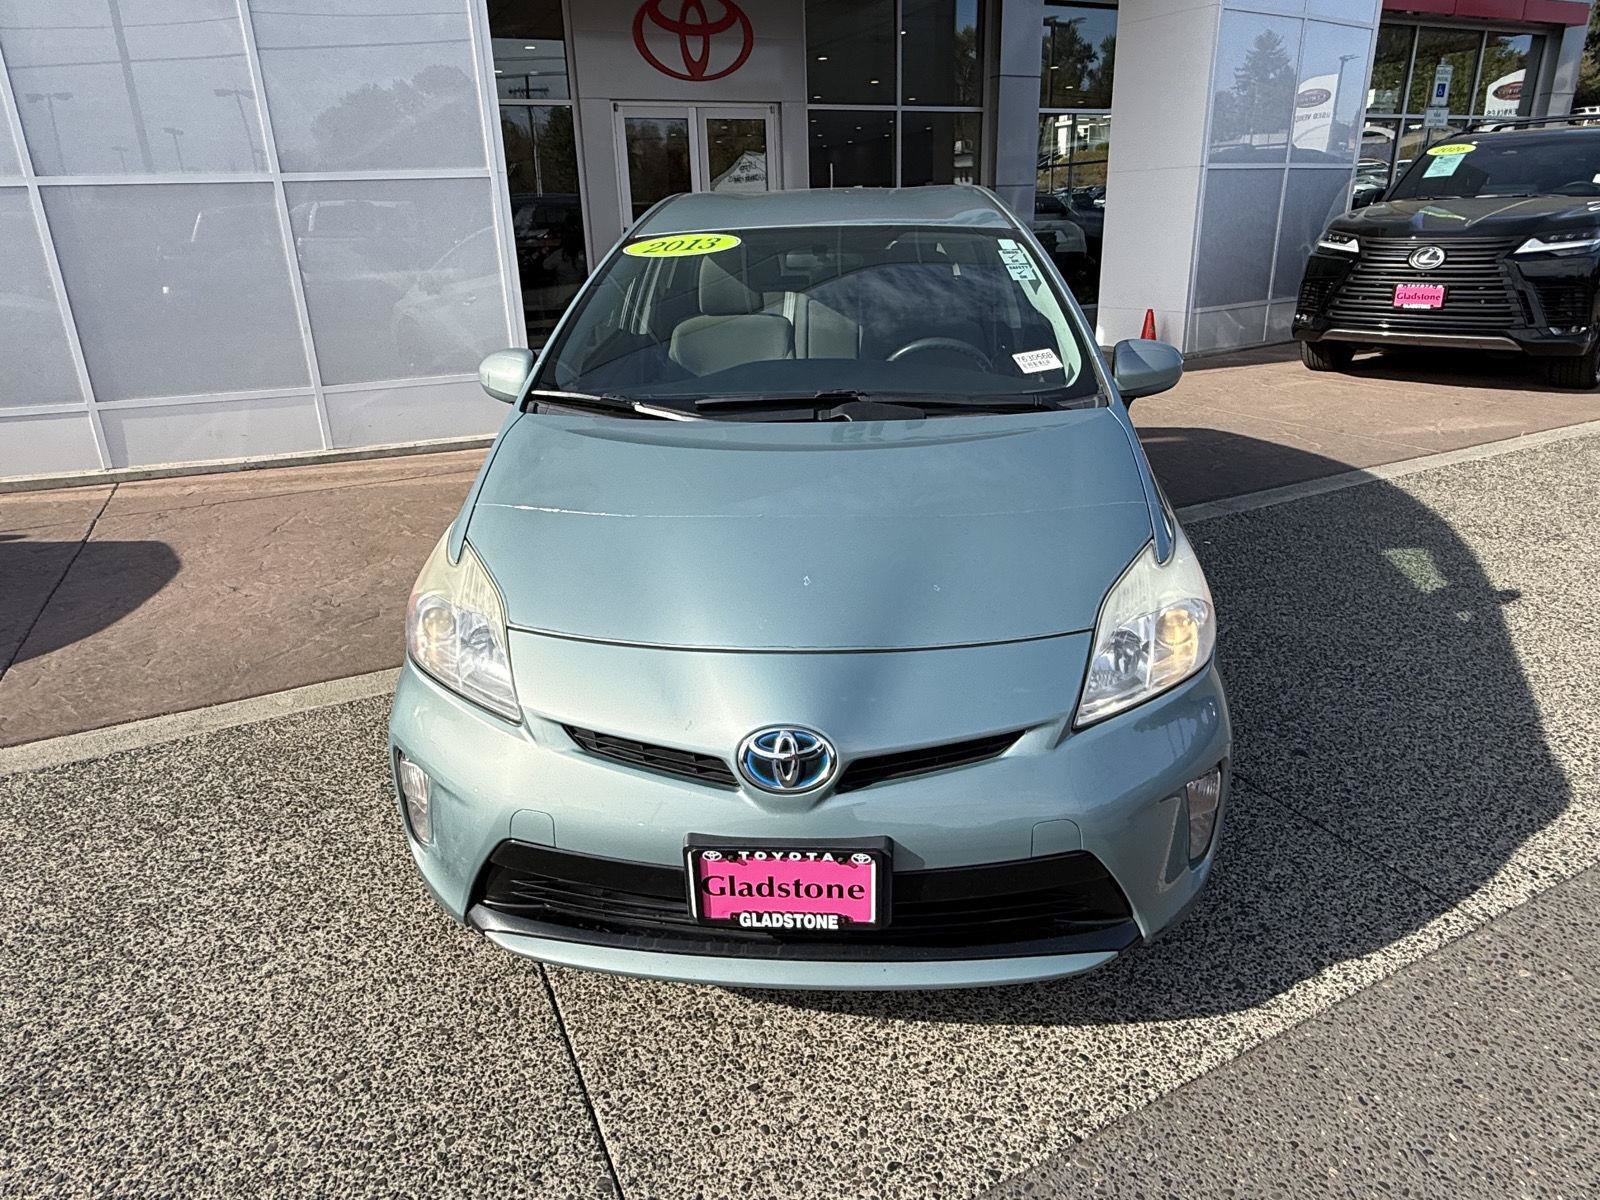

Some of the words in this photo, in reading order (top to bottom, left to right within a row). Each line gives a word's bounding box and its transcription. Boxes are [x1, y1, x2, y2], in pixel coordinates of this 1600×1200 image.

[642, 237, 722, 254] 2013
[1396, 292, 1441, 301] Gladstone
[738, 851, 833, 862] TOYOTA
[701, 875, 865, 899] Gladstone
[739, 912, 839, 929] GLADSTONE
